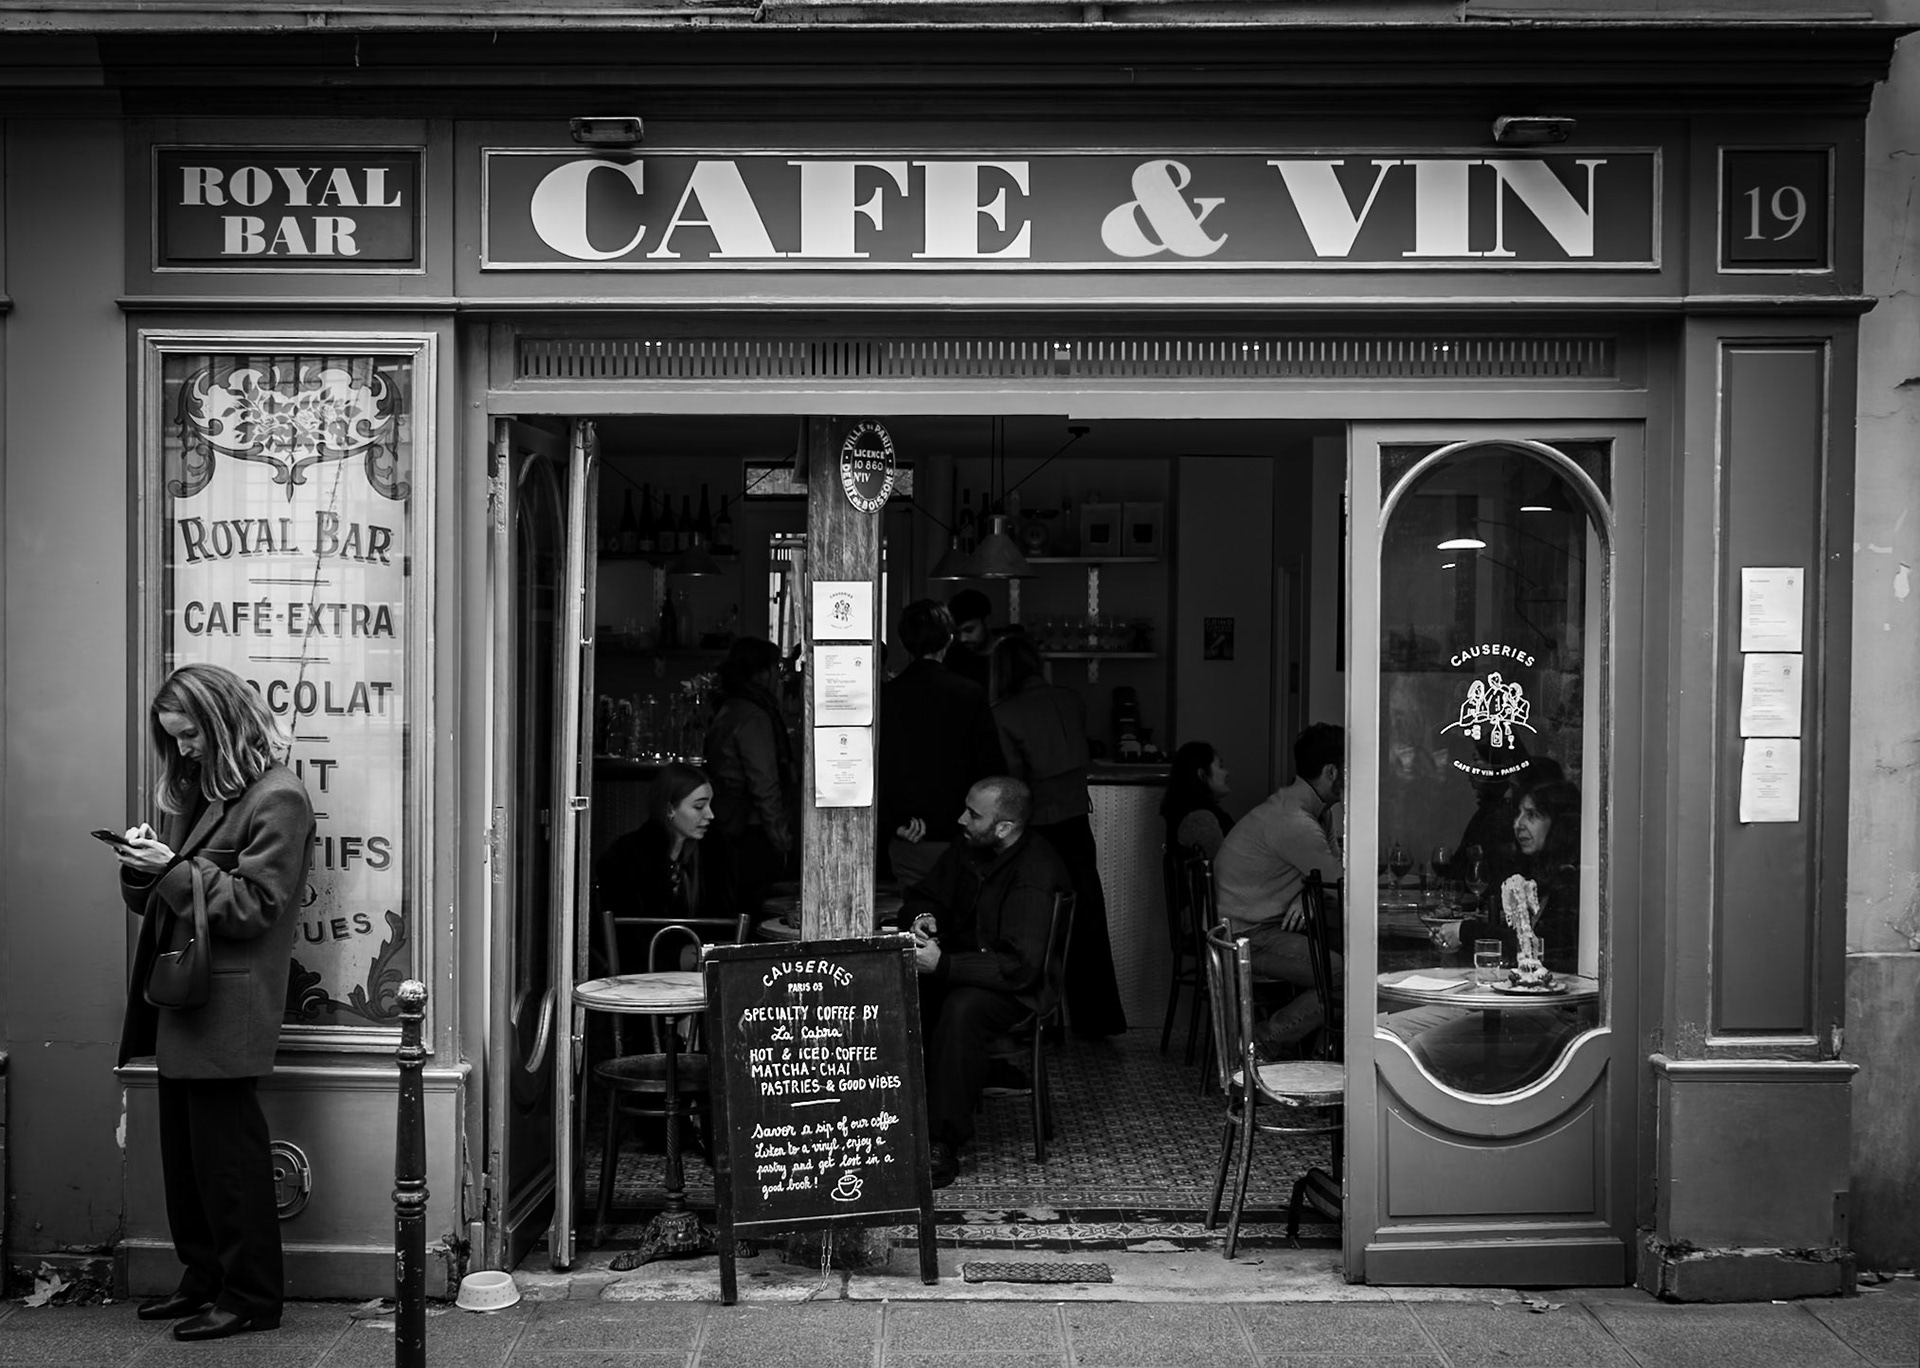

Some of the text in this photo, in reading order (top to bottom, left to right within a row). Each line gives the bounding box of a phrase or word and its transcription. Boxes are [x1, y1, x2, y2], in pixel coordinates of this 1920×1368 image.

[179, 166, 402, 208] ROYAL
[530, 158, 1607, 260] CAFE & VIN
[1743, 185, 1806, 241] 19
[220, 215, 361, 257] BAR
[844, 423, 866, 450] VILLE
[874, 424, 893, 455] PARIS
[865, 460, 884, 471] 860
[177, 510, 395, 566] ROYAL BAR
[1450, 643, 1536, 667] CAUSERIES
[246, 679, 394, 716] COLAT
[1500, 764, 1521, 776] PARIS
[762, 960, 853, 987] CAUSERIES
[788, 982, 811, 993] PARIS
[743, 1004, 879, 1022] SPECIALTY COFFEE BY
[771, 1024, 842, 1041] La Cabra
[749, 1047, 774, 1063] HOT
[781, 1047, 792, 1060] &
[820, 1062, 851, 1077] CHAI
[761, 1079, 820, 1097] PASTRIES
[826, 1079, 836, 1092] &
[839, 1078, 867, 1092] GOOD
[751, 1123, 797, 1139] Savor
[801, 1124, 814, 1136] a
[815, 1120, 834, 1139] sip
[837, 1115, 849, 1137] of
[787, 1141, 801, 1155] to
[801, 1144, 811, 1154] a
[846, 1135, 872, 1154] enjoy
[875, 1136, 886, 1146] a
[756, 1153, 895, 1181] pastry and get lost in a
[761, 1181, 785, 1200] good
